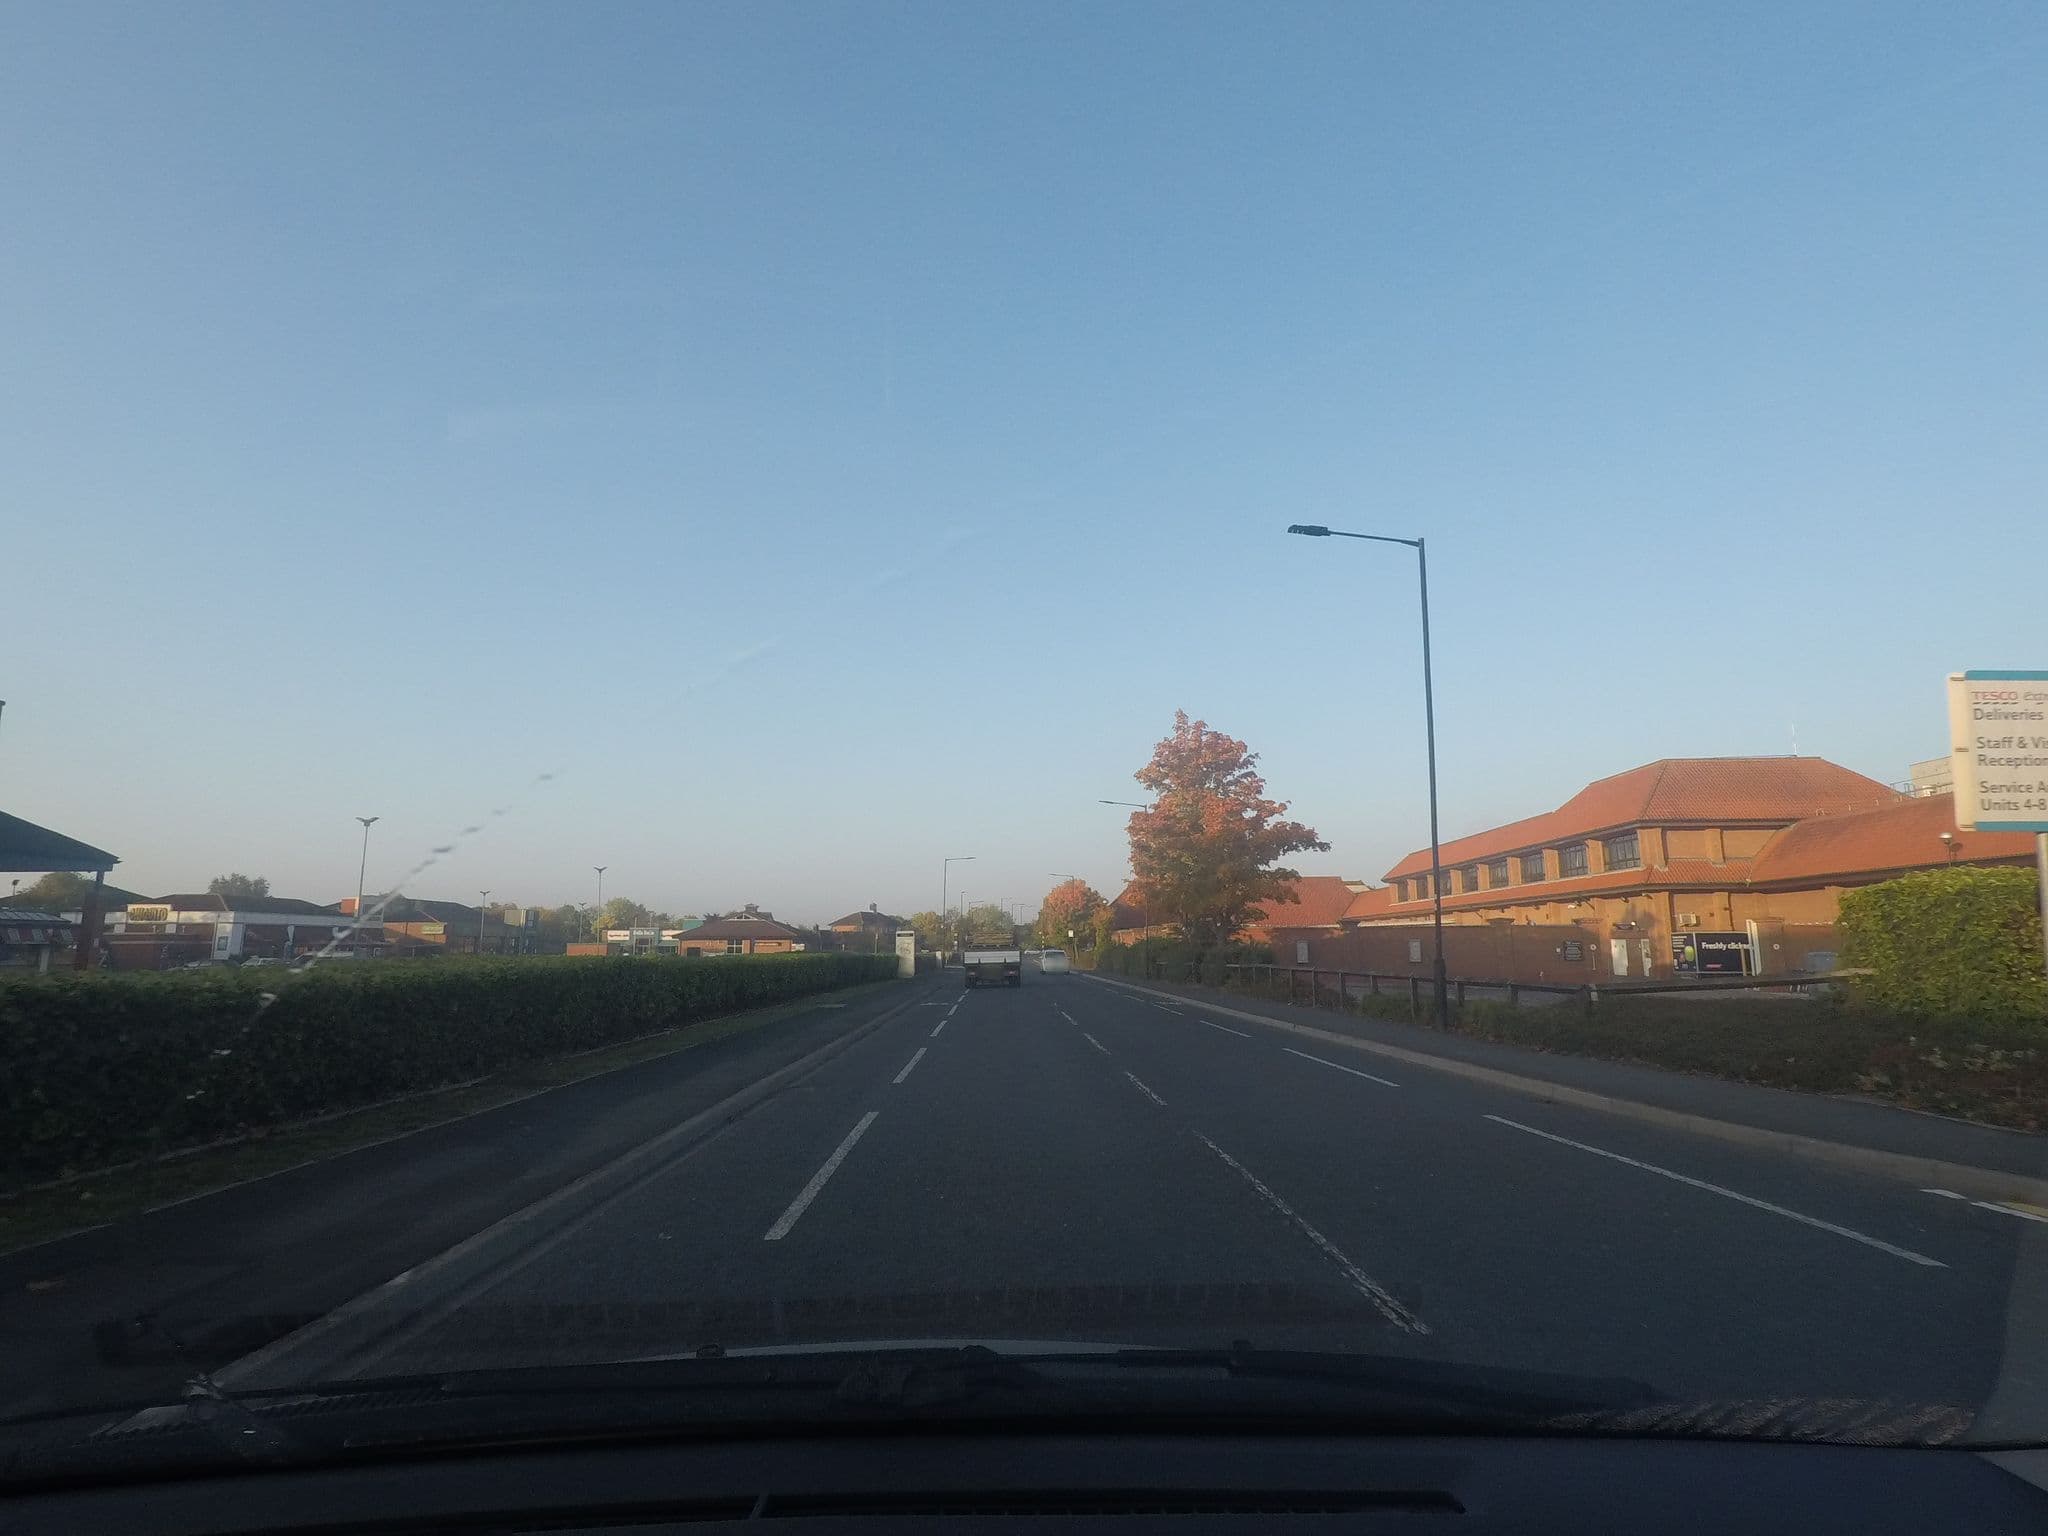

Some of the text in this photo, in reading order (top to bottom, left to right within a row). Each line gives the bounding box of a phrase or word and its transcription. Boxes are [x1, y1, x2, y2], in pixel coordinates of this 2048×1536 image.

[1971, 690, 2019, 702] TESCO
[1973, 707, 2045, 721] Deliveries
[1975, 736, 2014, 749] Staff
[2017, 736, 2028, 749] &
[1979, 780, 2034, 794] Service
[1981, 798, 2020, 811] Units
[1702, 942, 1727, 951] Freshly
